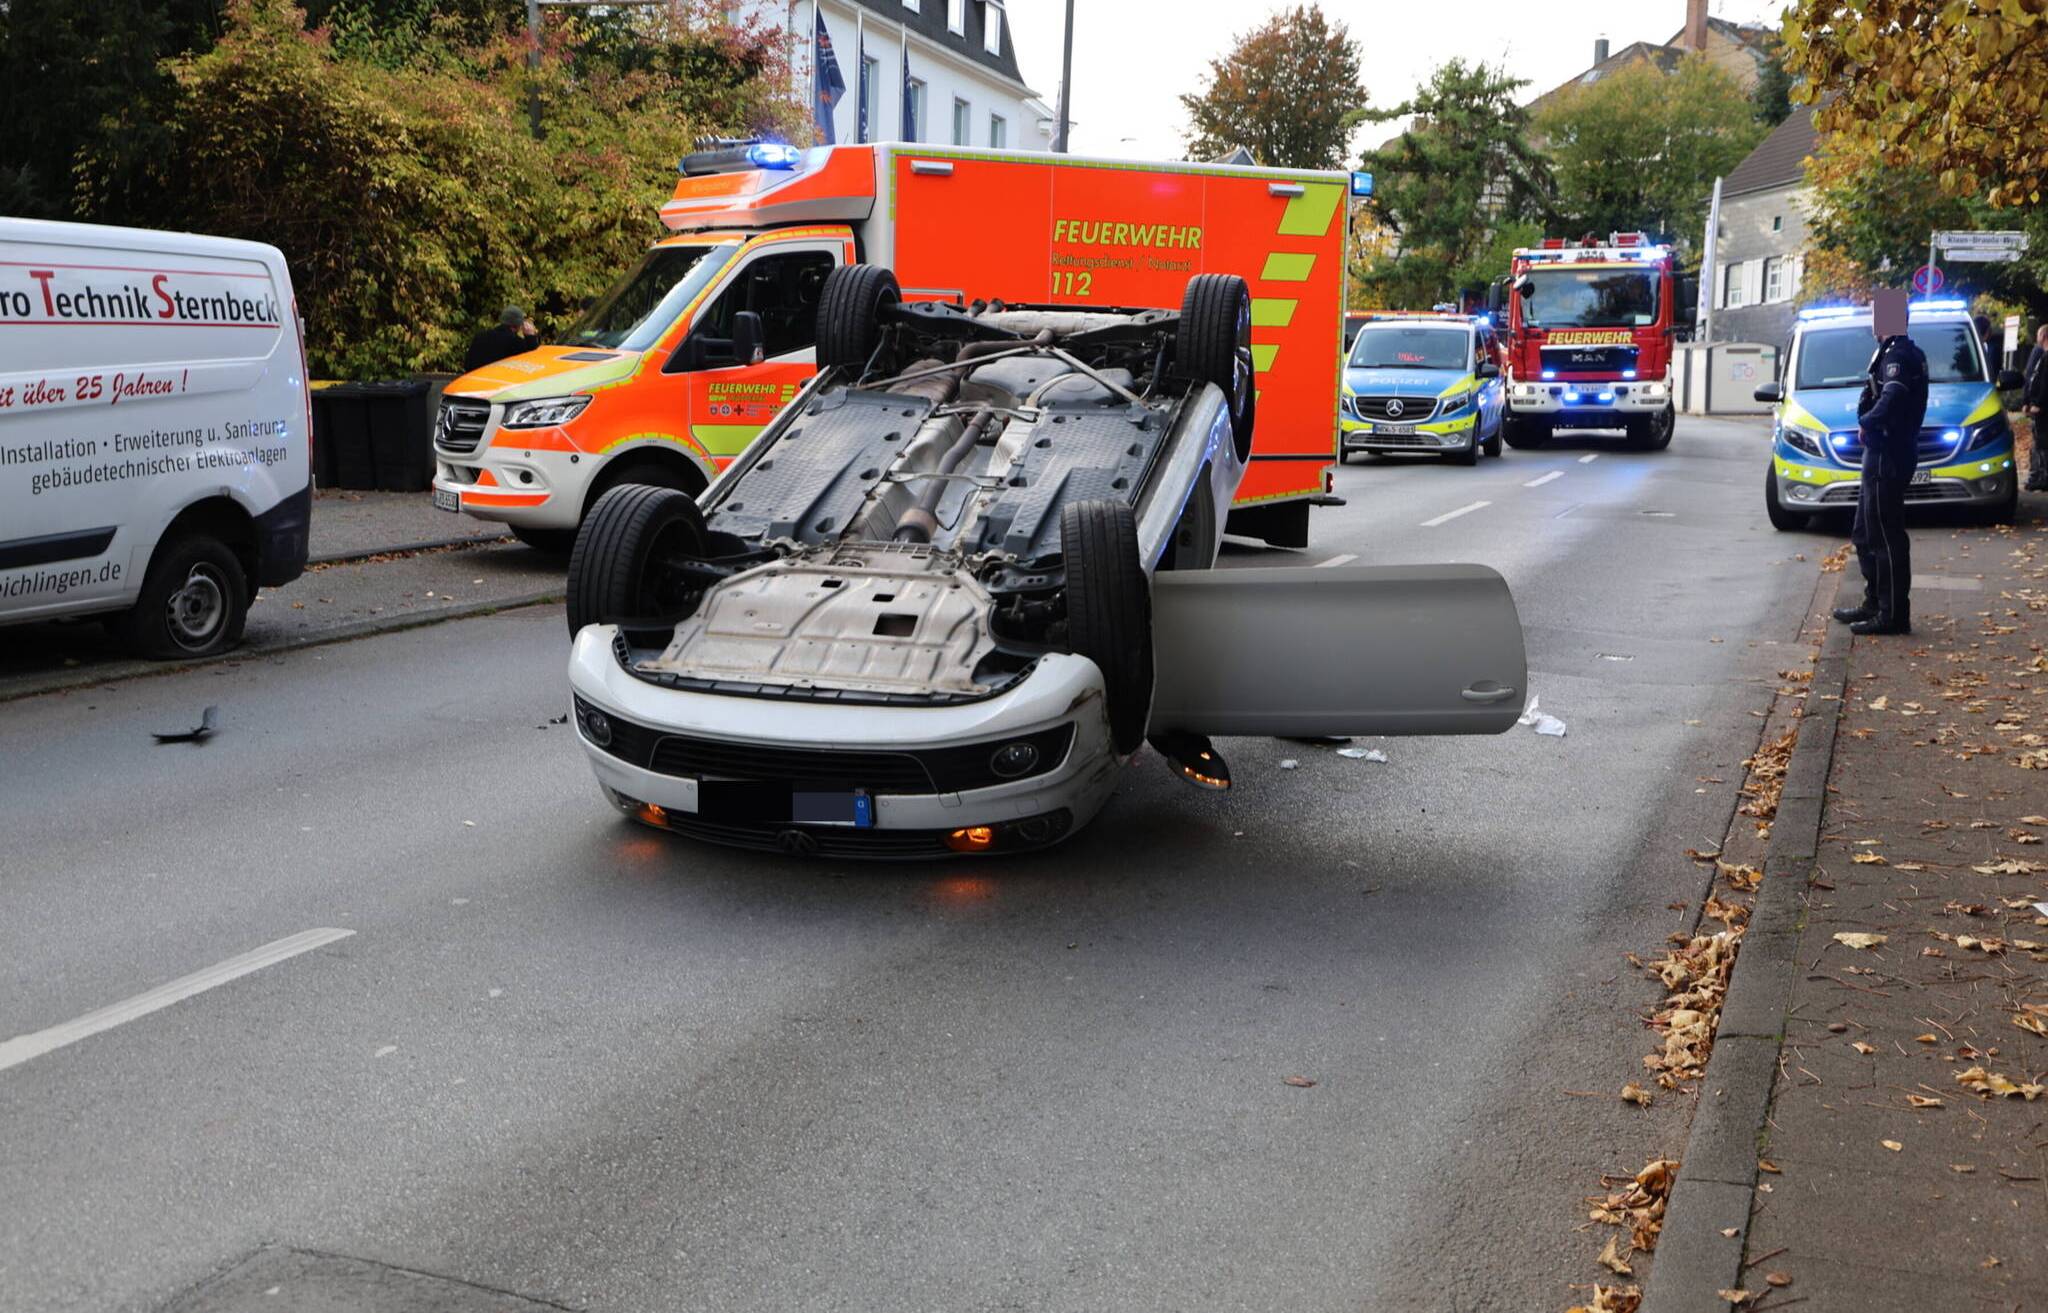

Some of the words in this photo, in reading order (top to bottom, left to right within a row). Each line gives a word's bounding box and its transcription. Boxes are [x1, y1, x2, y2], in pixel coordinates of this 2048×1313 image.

[1053, 219, 1202, 249] FEUERWEHR
[1052, 271, 1092, 296] 112
[1547, 331, 1633, 344] FEUERWEHR
[1571, 353, 1606, 362] MAN
[23, 378, 66, 405] über
[75, 375, 103, 400] 25
[111, 372, 174, 406] Jahren
[708, 383, 776, 394] FEUERWEHR
[1, 438, 96, 465] Installation
[114, 428, 203, 453] Erweiterung
[207, 428, 220, 442] u.
[32, 455, 191, 495] gebäudetechnischer
[196, 446, 287, 469] Elektroanlagen
[0, 560, 121, 598] ichlingen.de
